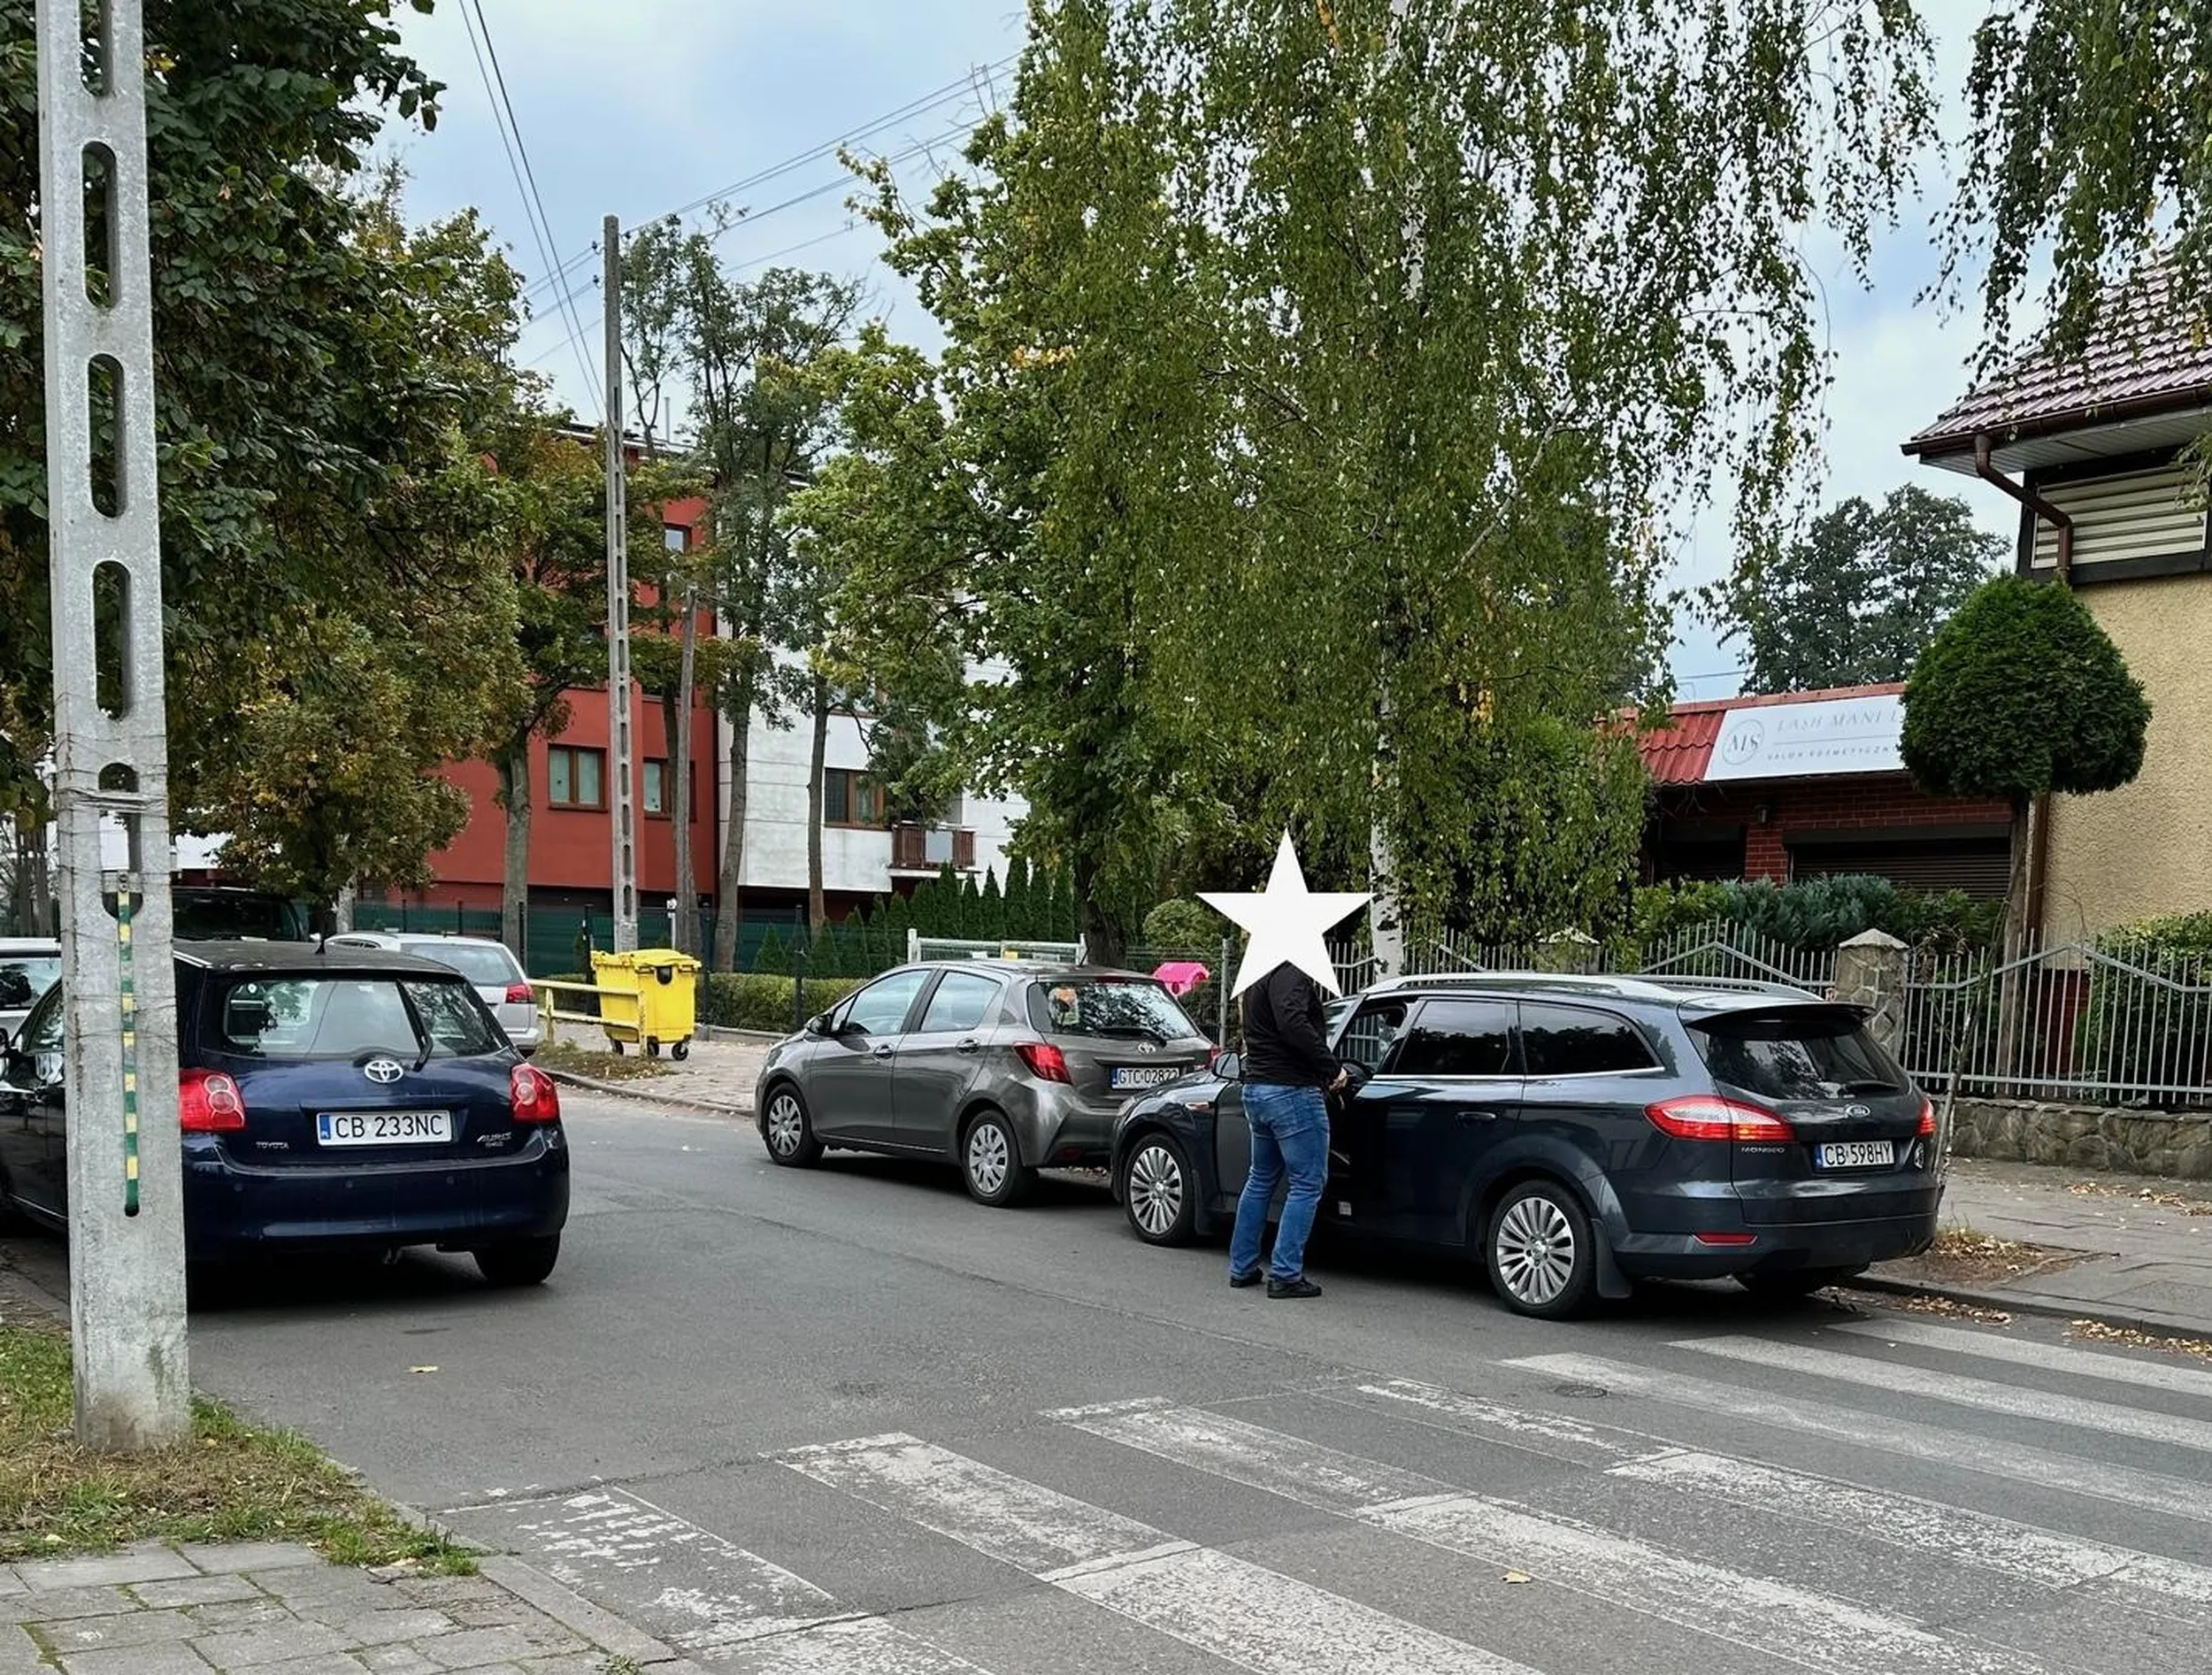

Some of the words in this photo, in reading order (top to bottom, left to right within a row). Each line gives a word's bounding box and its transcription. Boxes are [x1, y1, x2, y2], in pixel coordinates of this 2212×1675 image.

[1778, 716, 1824, 733] LASH
[1830, 708, 1881, 727] MANI
[1809, 745, 1895, 758] KOSMETYCZN
[1118, 1069, 1141, 1083] GTC
[335, 1117, 365, 1138] CB
[374, 1114, 442, 1137] 233NC
[1824, 1146, 1846, 1165] CB
[1850, 1143, 1891, 1164] 598HY
